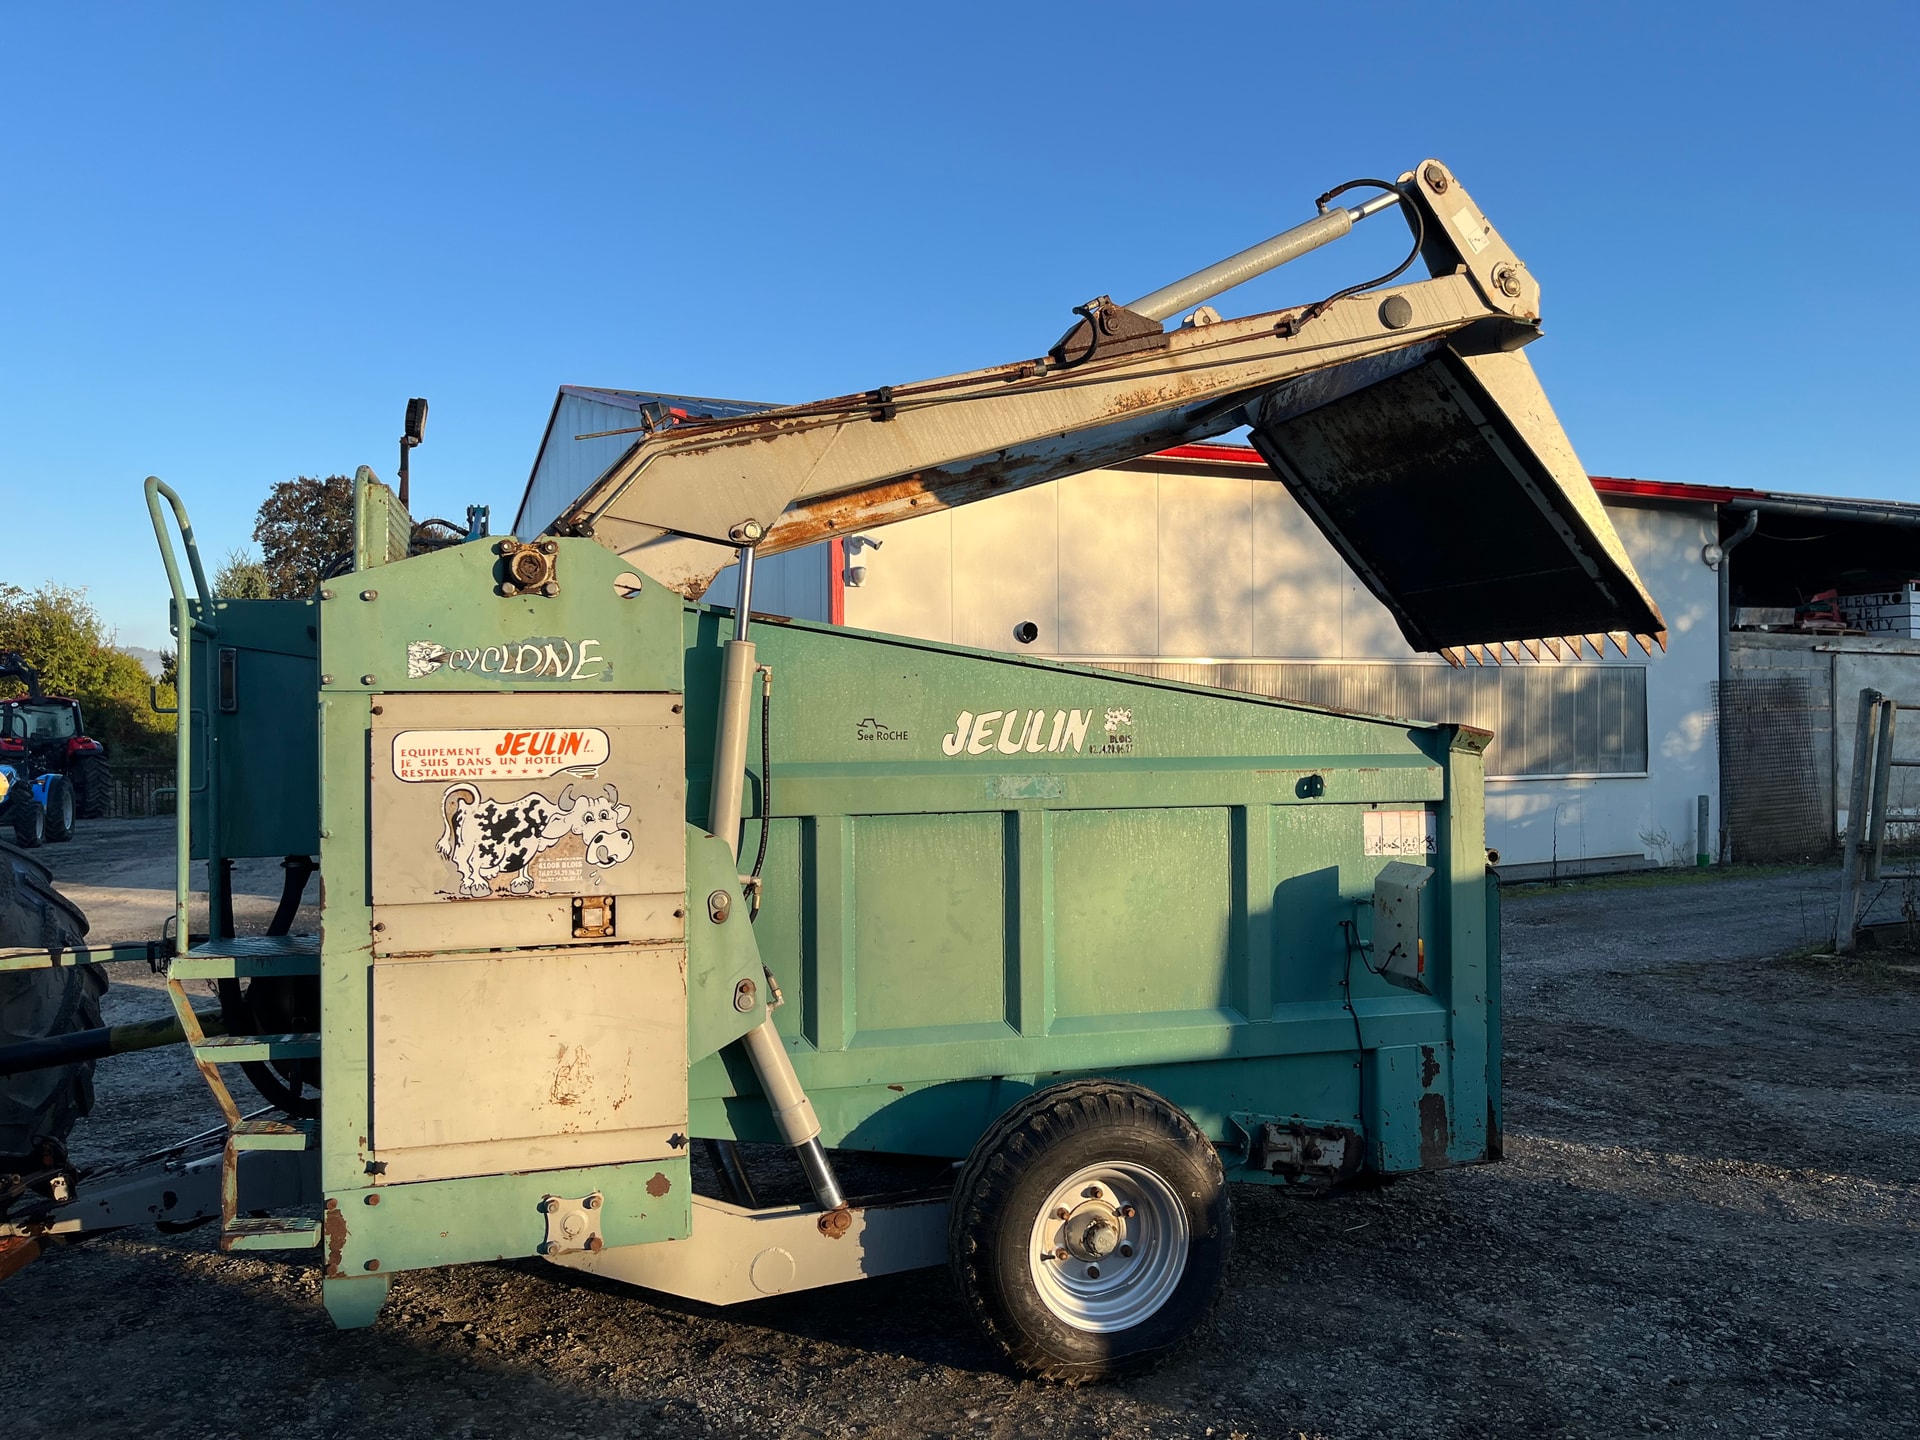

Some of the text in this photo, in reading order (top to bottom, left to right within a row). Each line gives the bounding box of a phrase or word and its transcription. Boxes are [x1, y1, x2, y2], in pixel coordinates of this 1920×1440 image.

[449, 638, 604, 680] CYCLONE
[857, 729, 875, 741] See
[941, 708, 1094, 755] JEULIN
[400, 748, 481, 757] EQUIPEMENT
[495, 732, 585, 757] JEULIN
[1109, 734, 1133, 744] BLOIS
[401, 756, 564, 769] JE SUIS DANS UN HOTEL
[401, 768, 484, 778] RESTAURANT
[561, 860, 583, 869] BLOIS
